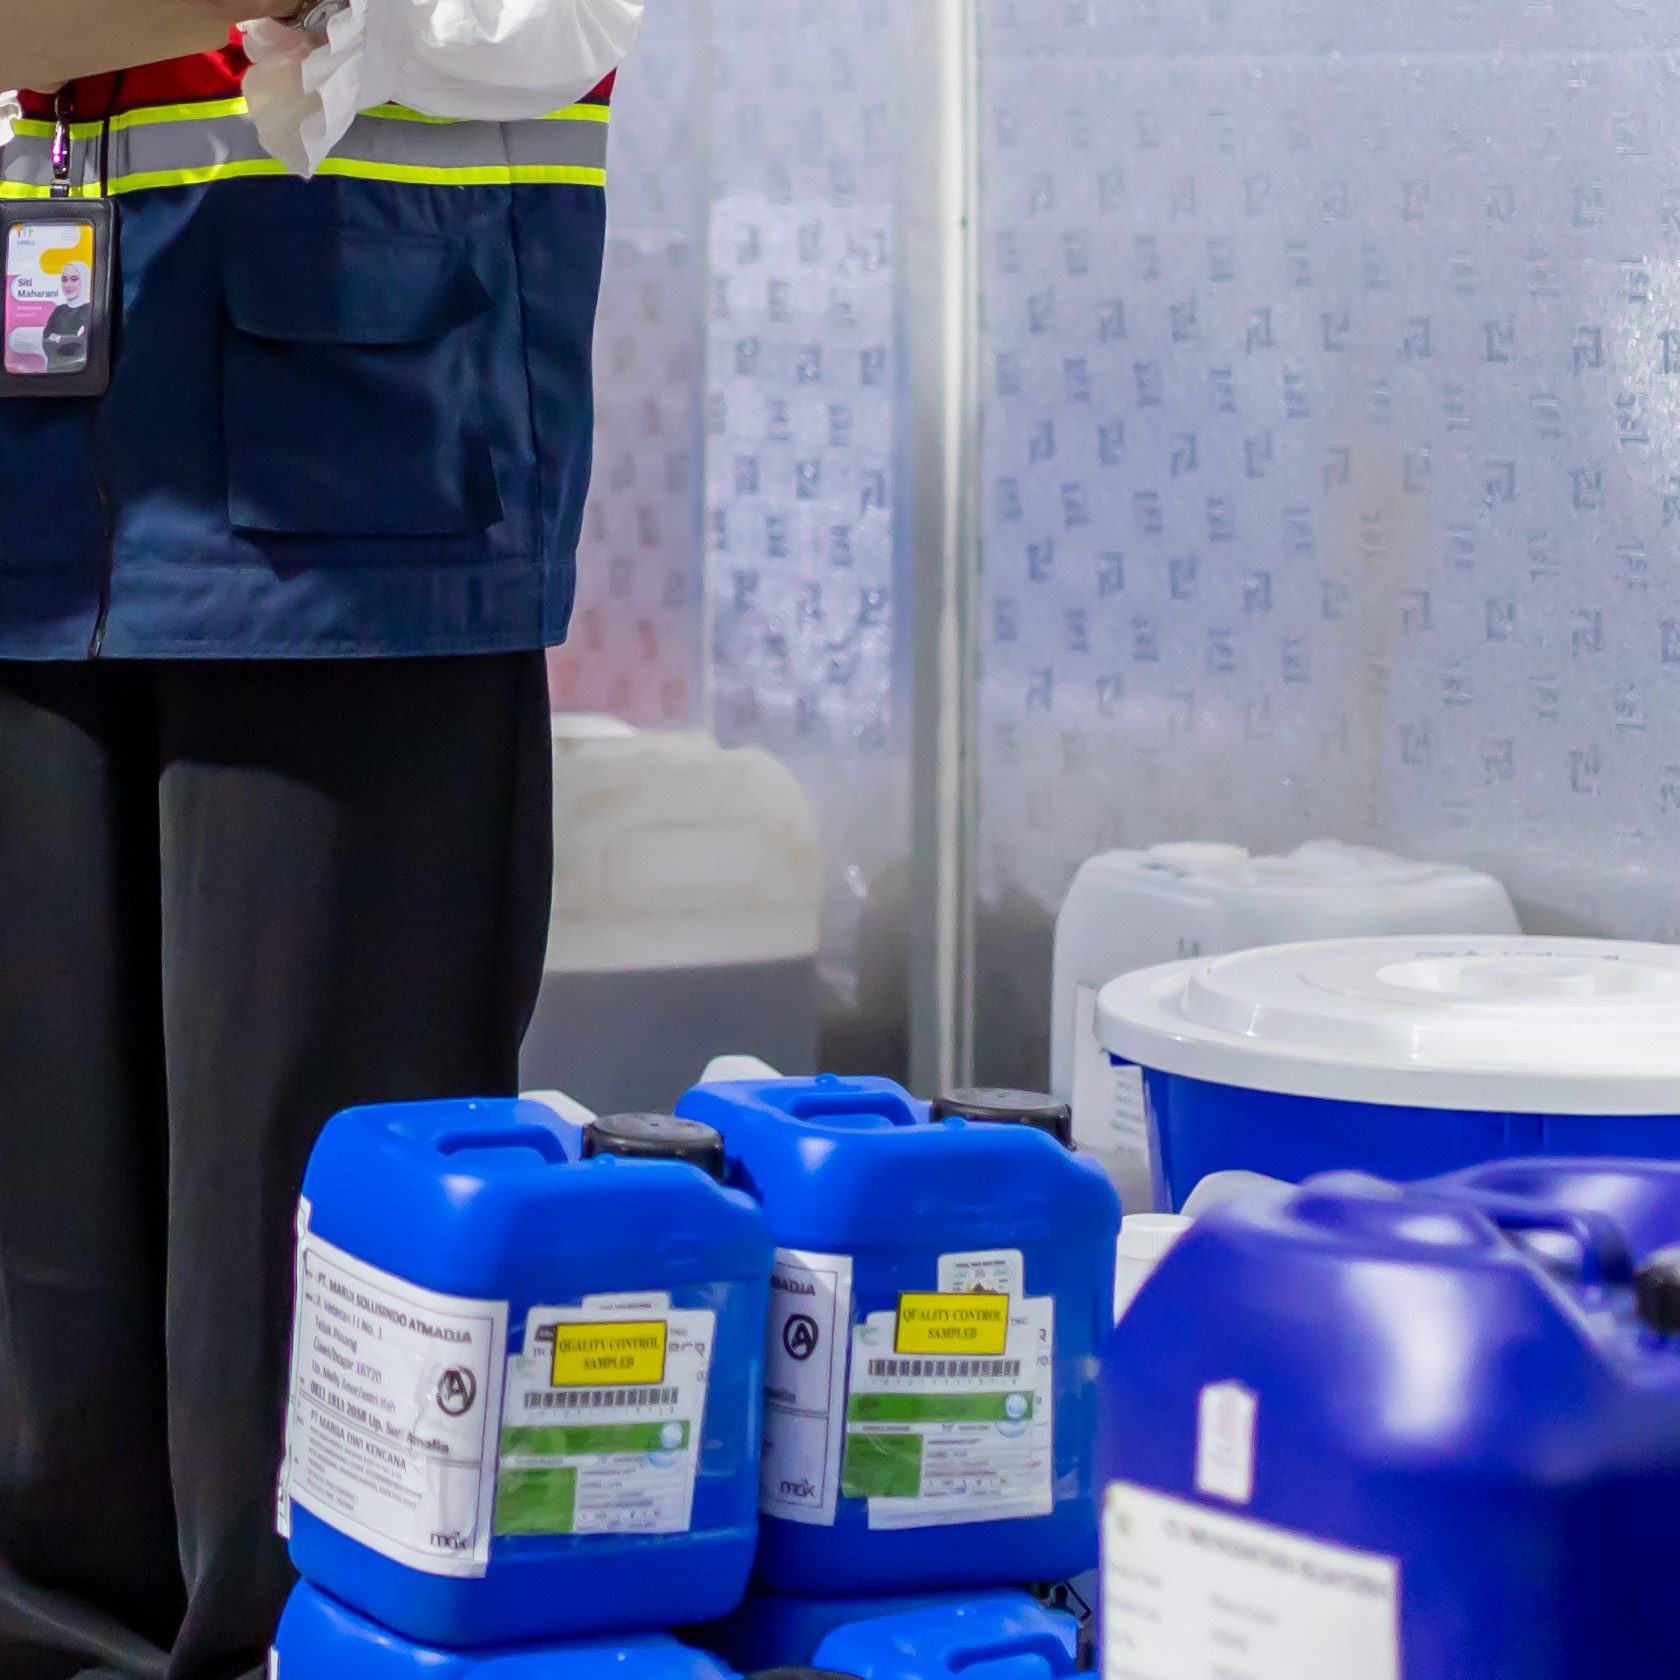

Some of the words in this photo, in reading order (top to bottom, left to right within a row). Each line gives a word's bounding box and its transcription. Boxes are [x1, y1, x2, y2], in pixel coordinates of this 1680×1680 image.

[17, 288, 59, 298] Maharani
[903, 1308, 951, 1323] QUALITY
[952, 1308, 1004, 1323] CONTROL
[927, 1326, 978, 1340] SAMPLED
[559, 1336, 607, 1355] QUALITY
[608, 1336, 661, 1353] CONTROL
[583, 1356, 635, 1370] SAMPLED
[365, 1440, 407, 1470] KENCANA
